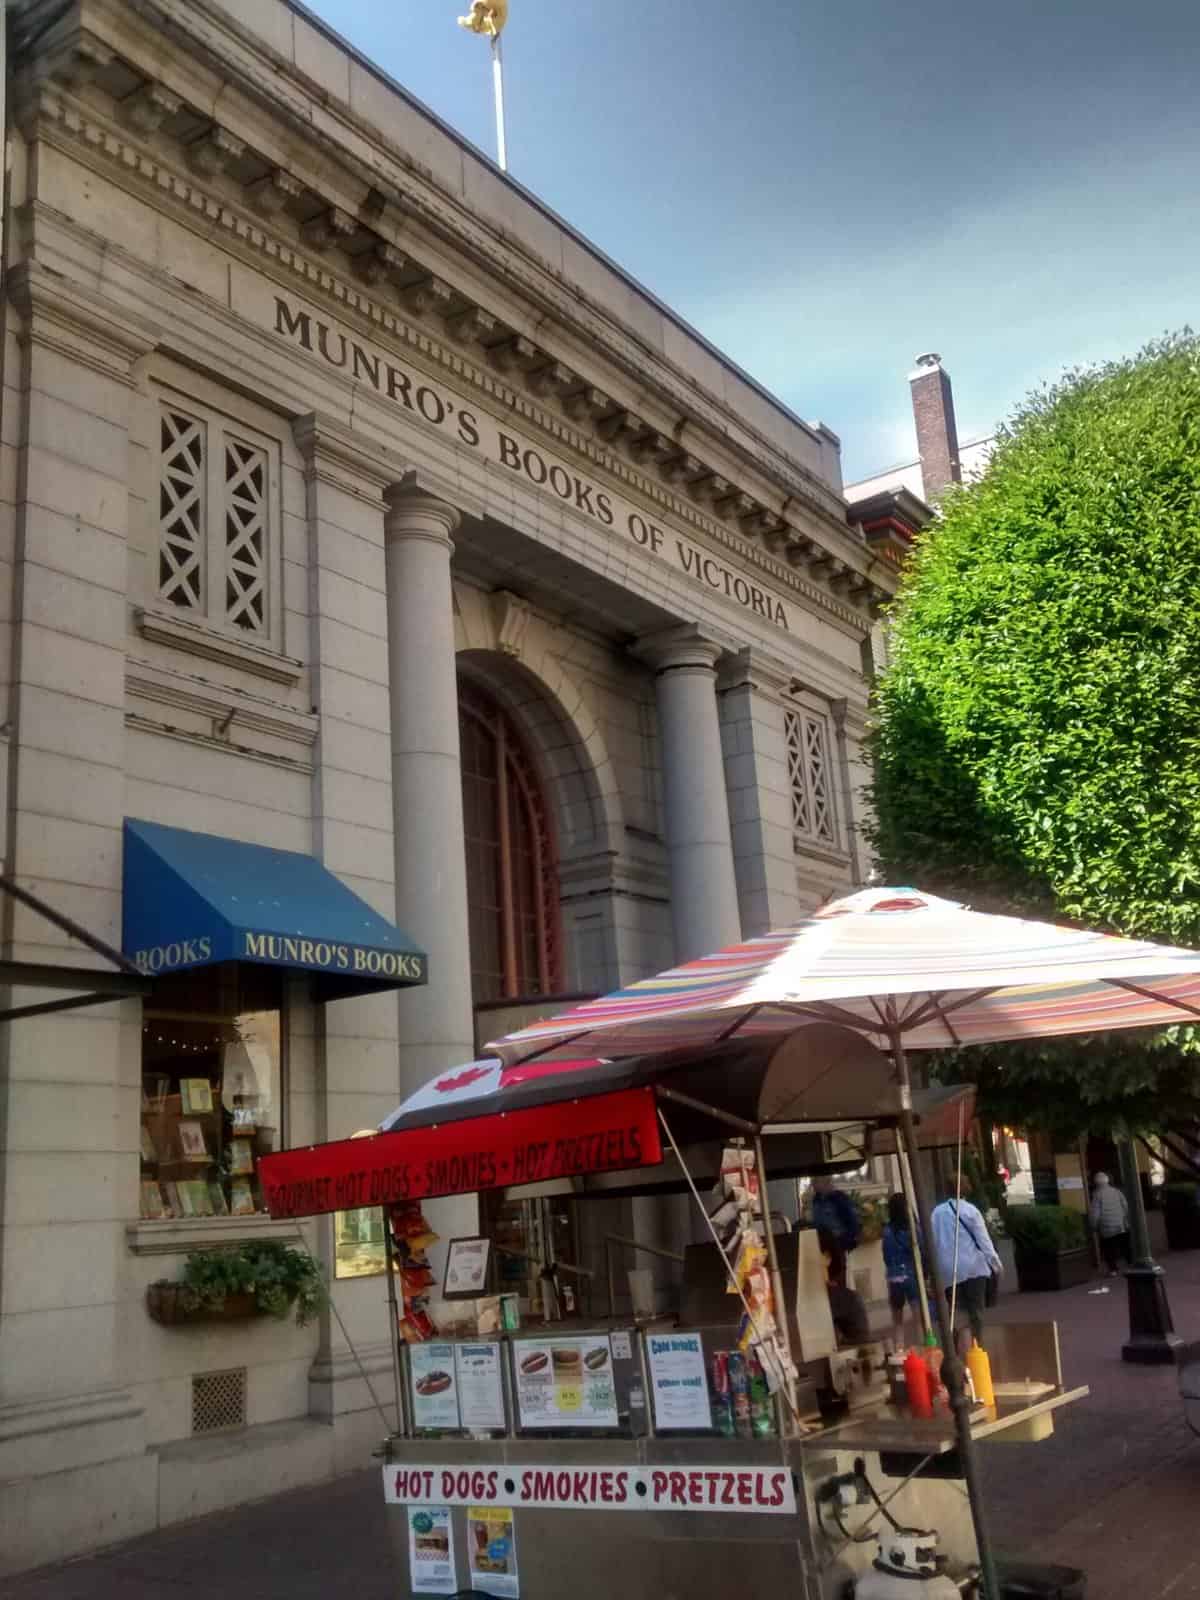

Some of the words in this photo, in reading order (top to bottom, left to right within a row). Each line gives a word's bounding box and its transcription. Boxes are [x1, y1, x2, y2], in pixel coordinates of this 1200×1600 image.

[273, 296, 480, 446] MUNRO'S
[498, 432, 613, 525] BOOKS
[628, 513, 664, 552] OF
[675, 539, 790, 630] VICTORIA
[135, 936, 211, 972] BOOKS
[245, 932, 348, 968] MUNRO'S
[354, 948, 422, 978] BOOKS
[335, 1170, 367, 1206] HOT
[370, 1162, 410, 1203] DOGS
[424, 1150, 496, 1195] SMOKIES
[512, 1140, 549, 1181] HOT
[553, 1125, 642, 1172] PRETZELS
[394, 1471, 433, 1499] HOT
[441, 1471, 498, 1500] DOGS
[520, 1471, 628, 1504] SMOKIES
[651, 1471, 786, 1507] PRETZELS
